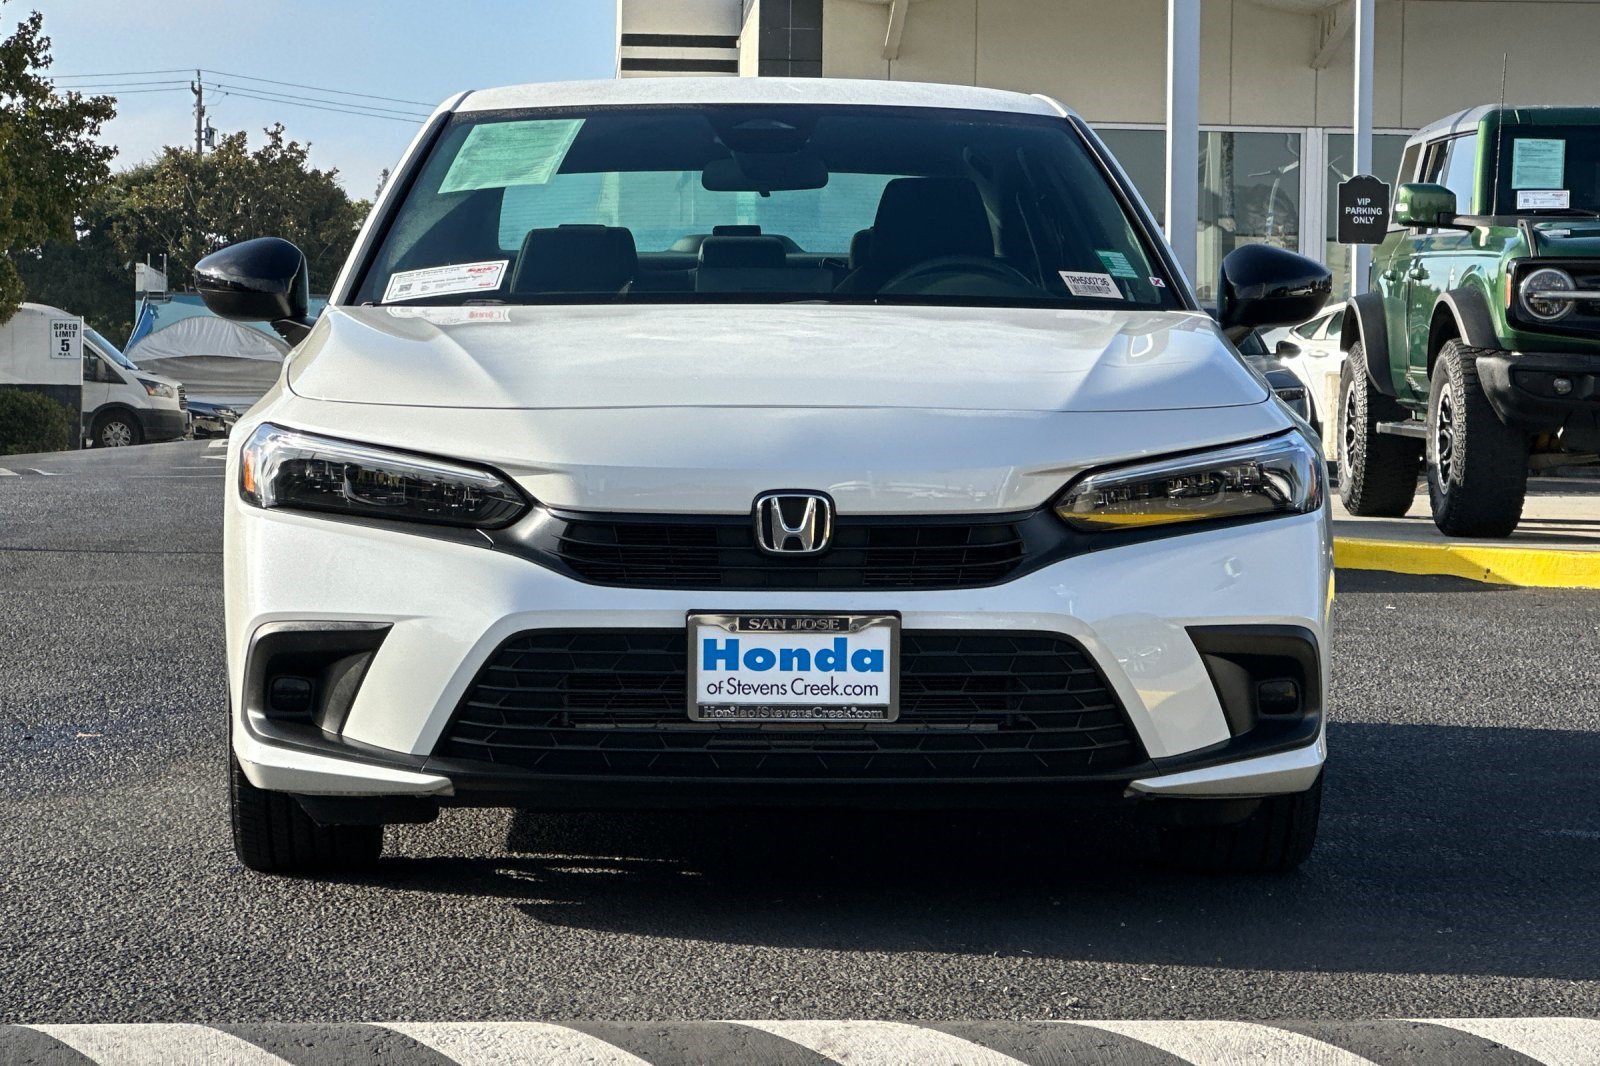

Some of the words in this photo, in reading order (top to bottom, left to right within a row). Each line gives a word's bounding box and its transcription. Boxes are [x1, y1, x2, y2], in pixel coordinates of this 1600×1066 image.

[1357, 197, 1371, 206] VIP
[1345, 207, 1382, 215] PARKING
[1352, 216, 1375, 224] ONLY
[60, 338, 70, 352] 5
[748, 618, 786, 630] SAN
[791, 618, 840, 630] JOSE
[703, 637, 884, 672] Honda
[706, 680, 724, 695] of
[727, 677, 787, 695] Stevens
[791, 676, 879, 696] Creek.com
